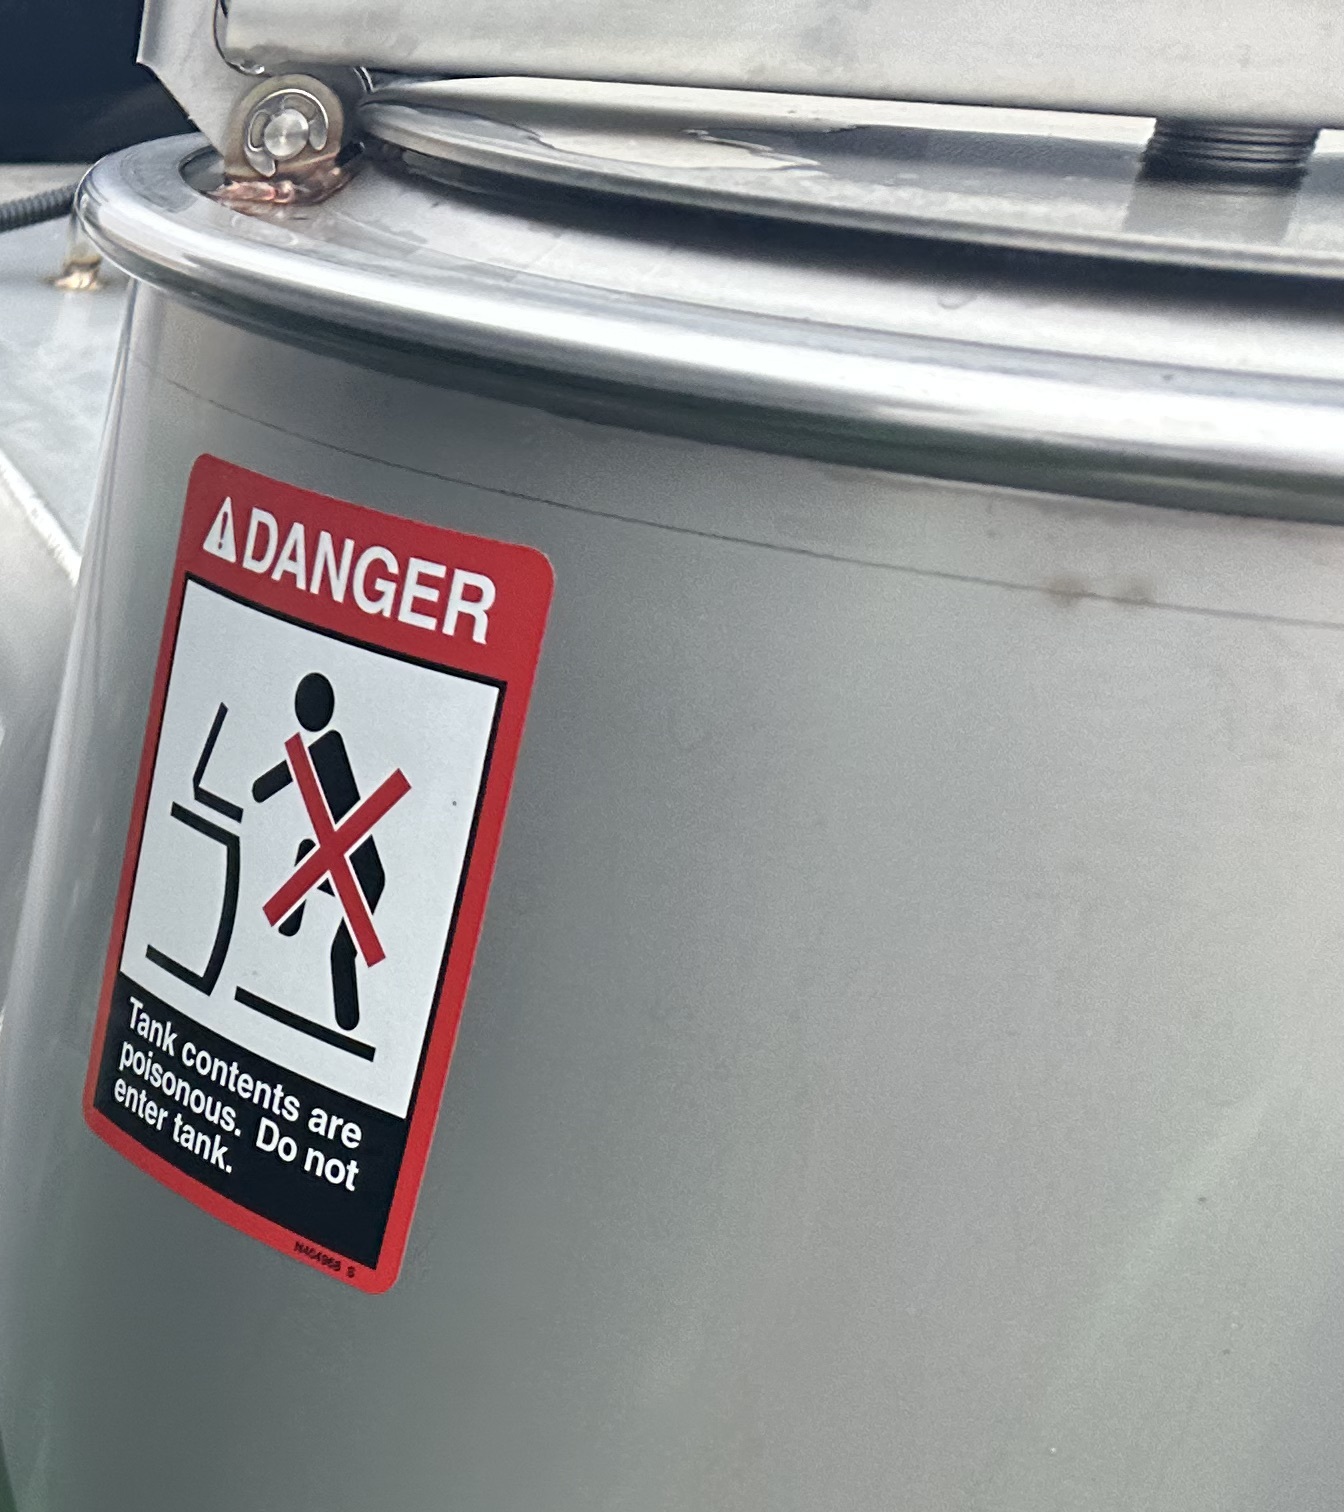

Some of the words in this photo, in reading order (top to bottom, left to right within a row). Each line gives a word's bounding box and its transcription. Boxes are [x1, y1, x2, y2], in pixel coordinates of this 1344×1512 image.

[242, 506, 497, 645] DANGER
[113, 1076, 169, 1132] enter
[172, 1113, 233, 1174] tank.
[118, 1040, 243, 1137] poisonous.
[255, 1117, 298, 1162] Do
[303, 1144, 360, 1192] not
[128, 996, 179, 1058] Tank
[181, 1040, 300, 1122] contents
[308, 1107, 363, 1149] are
